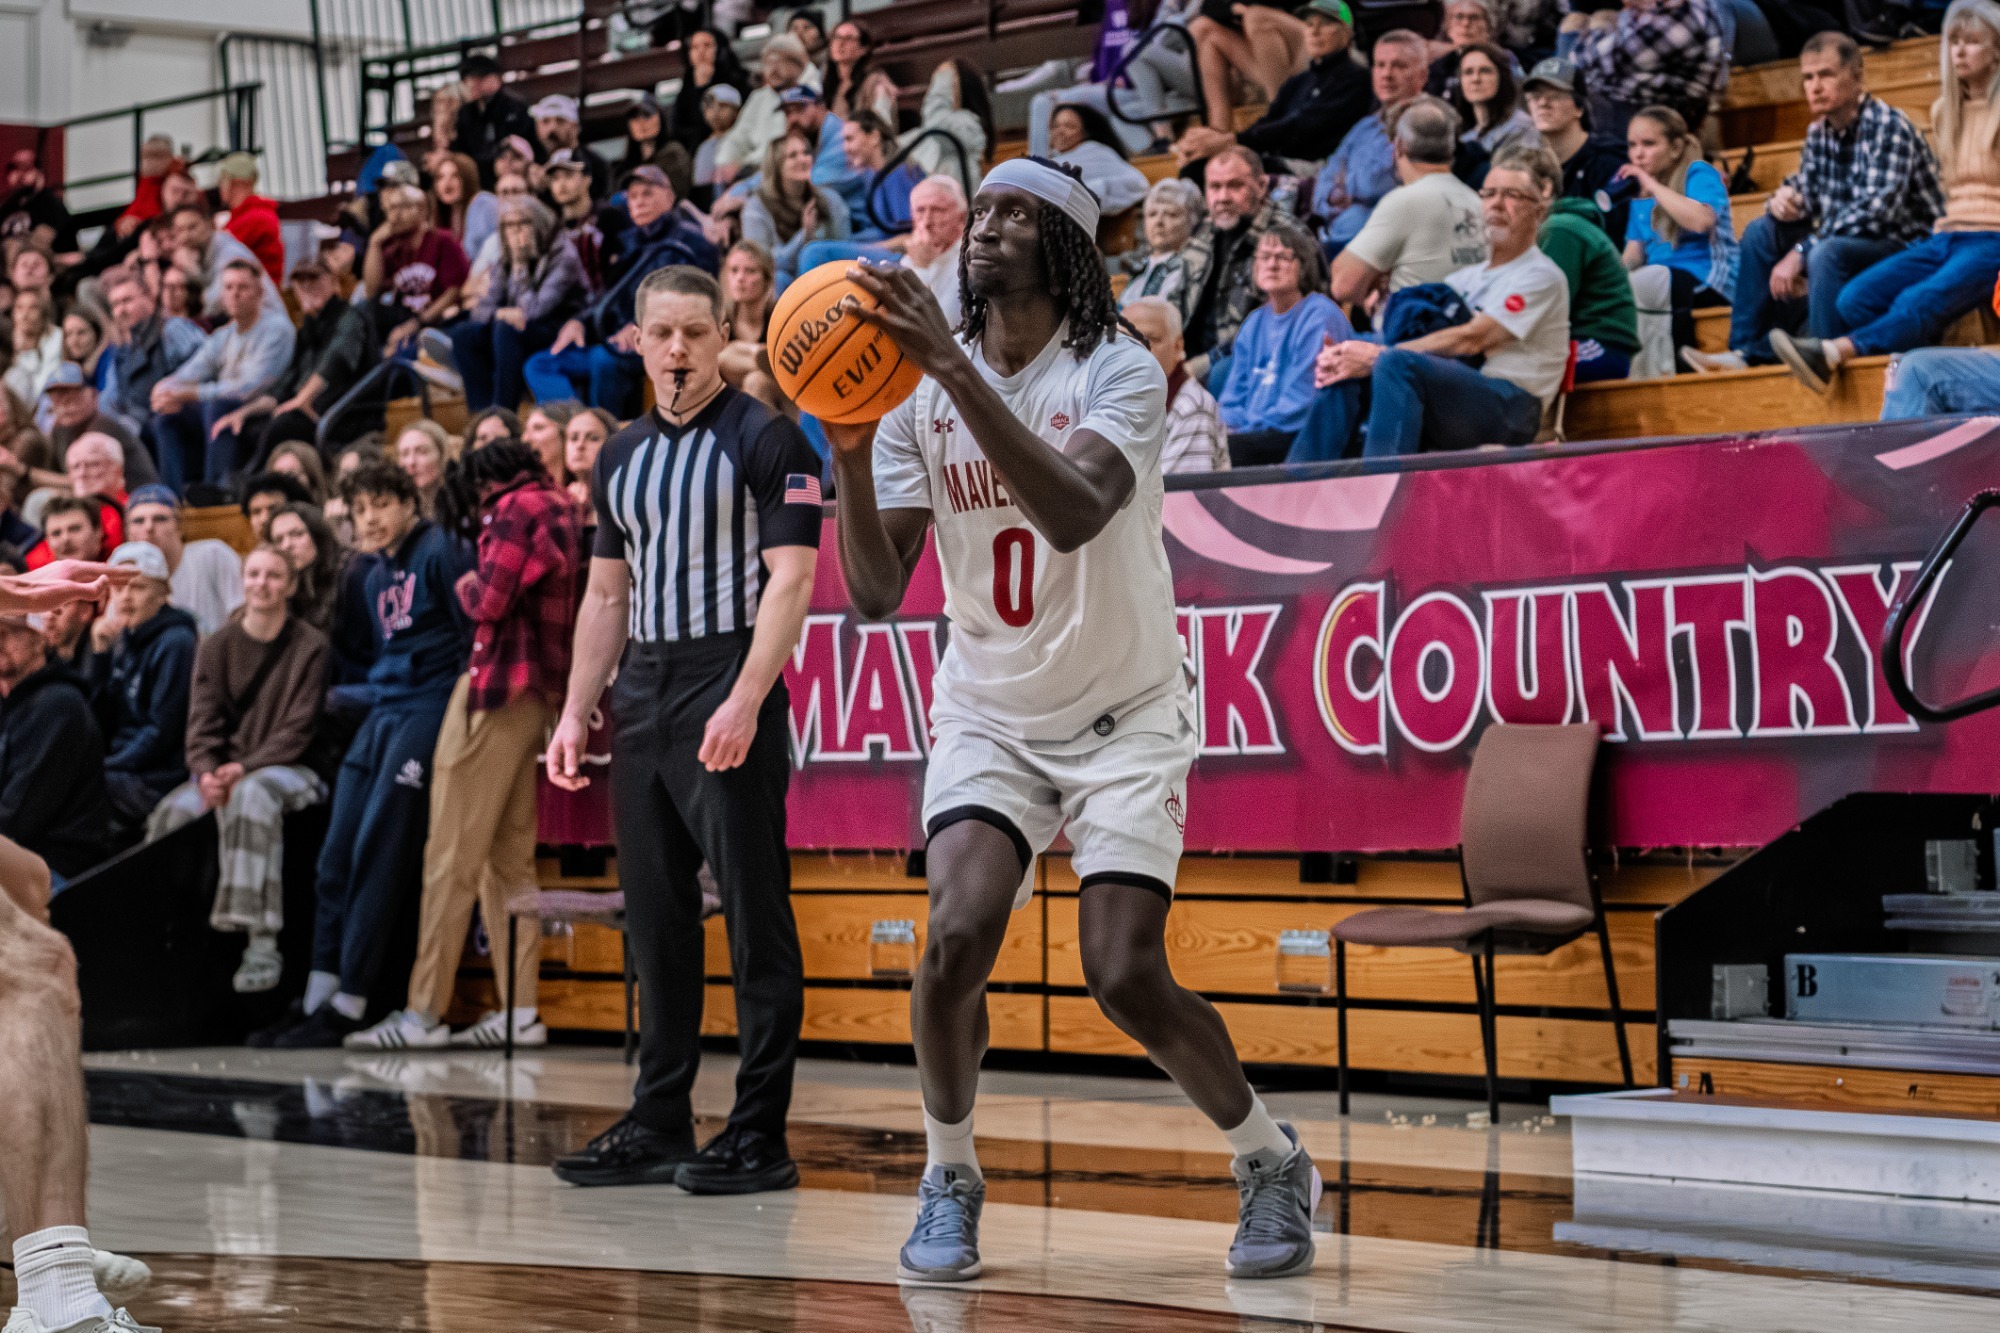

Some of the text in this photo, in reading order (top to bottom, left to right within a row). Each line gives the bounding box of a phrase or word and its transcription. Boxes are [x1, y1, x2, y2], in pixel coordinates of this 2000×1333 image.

[943, 459, 1015, 514] MAVE
[992, 527, 1035, 627] 0
[1312, 560, 1952, 755] COUNTRY
[1796, 964, 1818, 997] B
